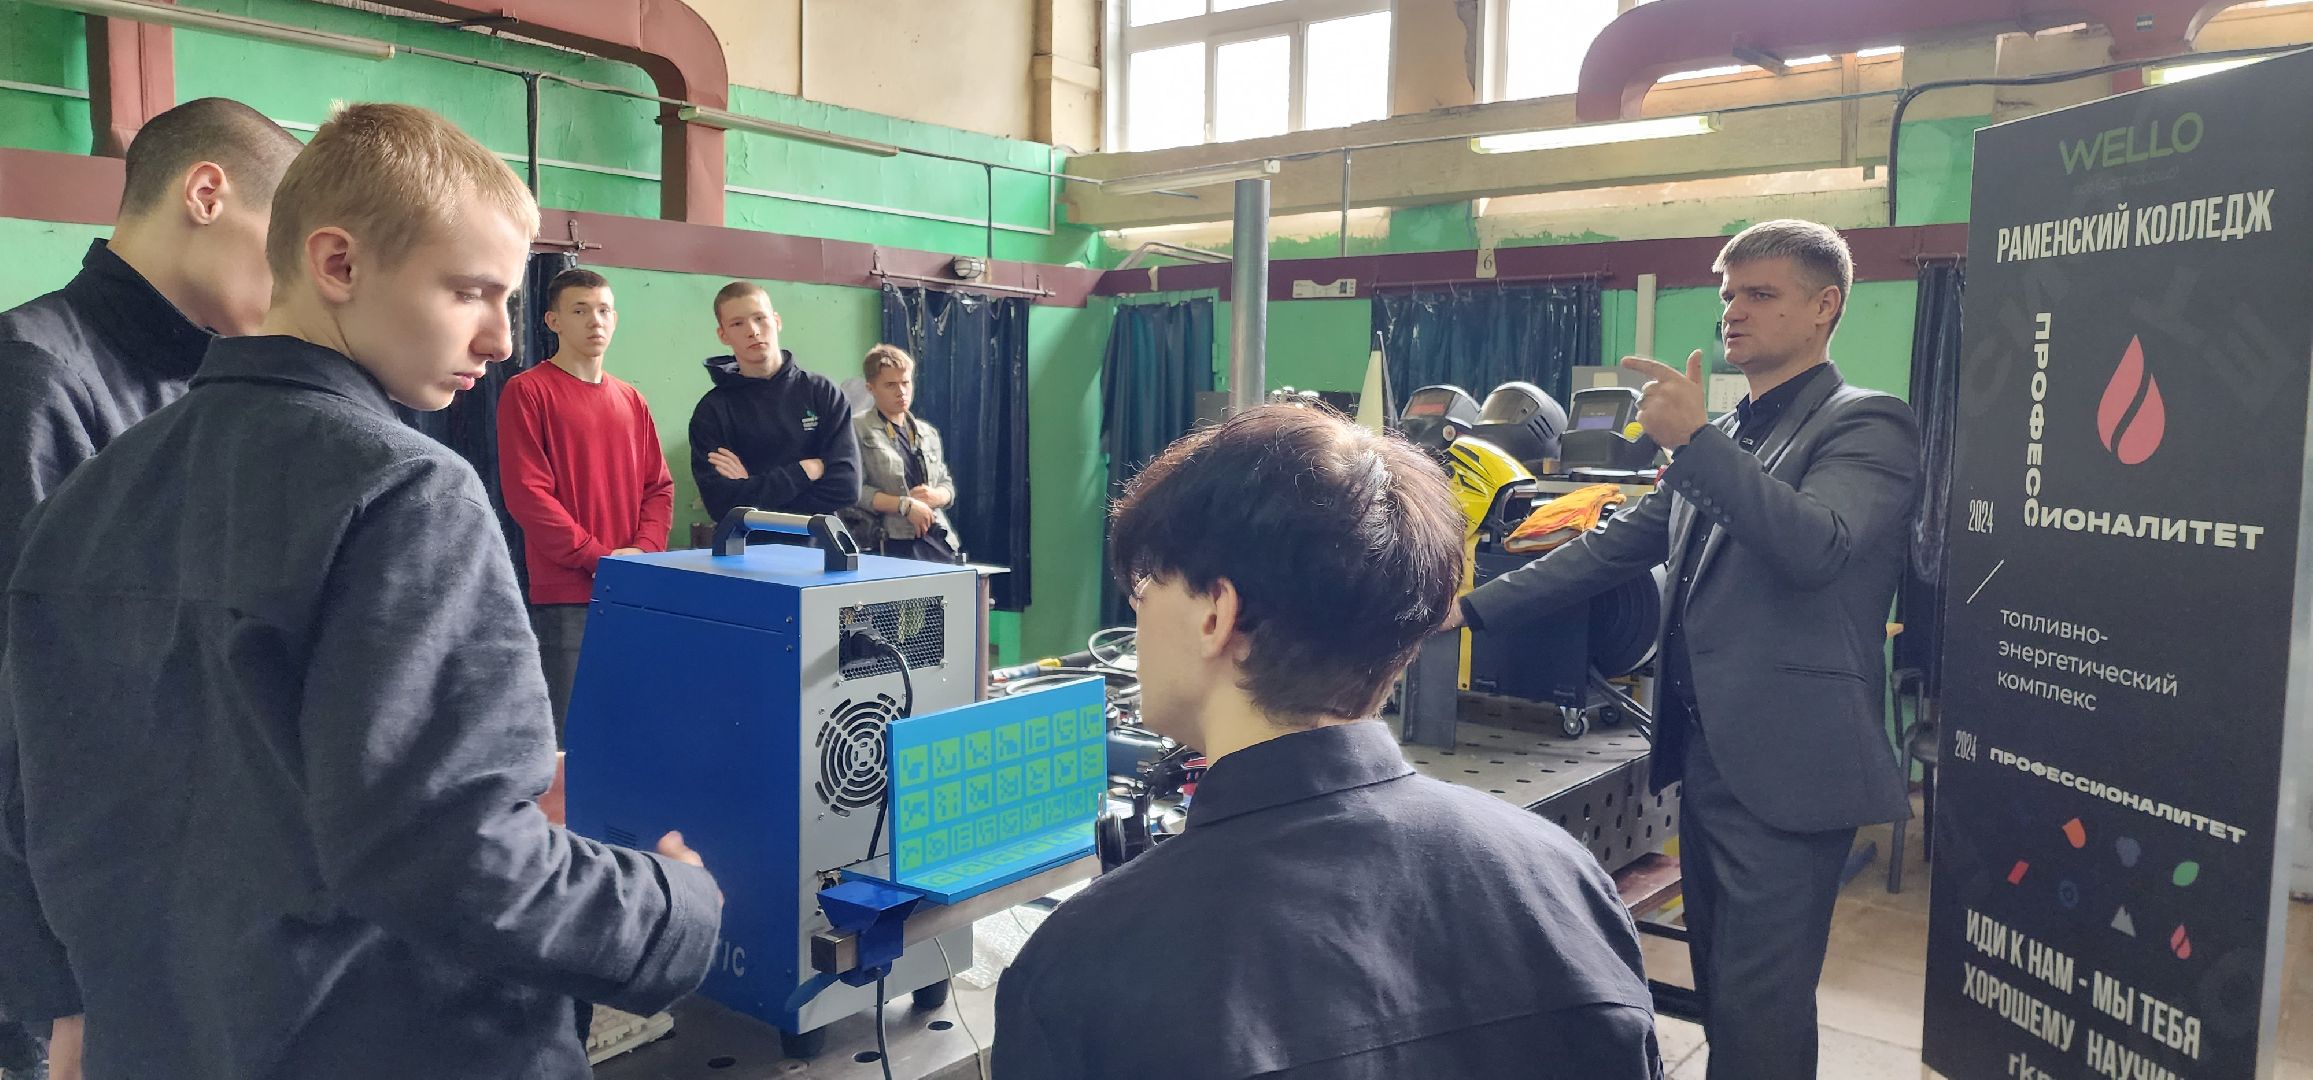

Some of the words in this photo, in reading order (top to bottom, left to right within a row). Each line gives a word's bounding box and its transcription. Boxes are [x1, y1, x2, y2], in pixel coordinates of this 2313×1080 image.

[2059, 112, 2204, 175] WELLO
[1997, 202, 2129, 263] РАМЕНСКИЙ
[2135, 188, 2275, 247] КОЛЛЕДЖ
[1483, 254, 1493, 270] 6
[1968, 499, 1994, 534] 2024
[2000, 609, 2108, 645] топливно-
[1997, 671, 2097, 711] комплекс
[1998, 640, 2178, 698] энергетический
[1955, 730, 1977, 762] 2024
[1989, 747, 2246, 844] ПРОФЕССИОНАЛИТЕТ
[1966, 909, 2008, 959] ИДИ
[2010, 929, 2024, 969] К
[2027, 938, 2075, 995] НАМ
[2092, 970, 2135, 1026] МЫ
[2140, 992, 2201, 1060] ТЕБЯ
[1962, 961, 2076, 1052] ХОРОШЕМУ
[2086, 1028, 2185, 1080] НАУЧИ
